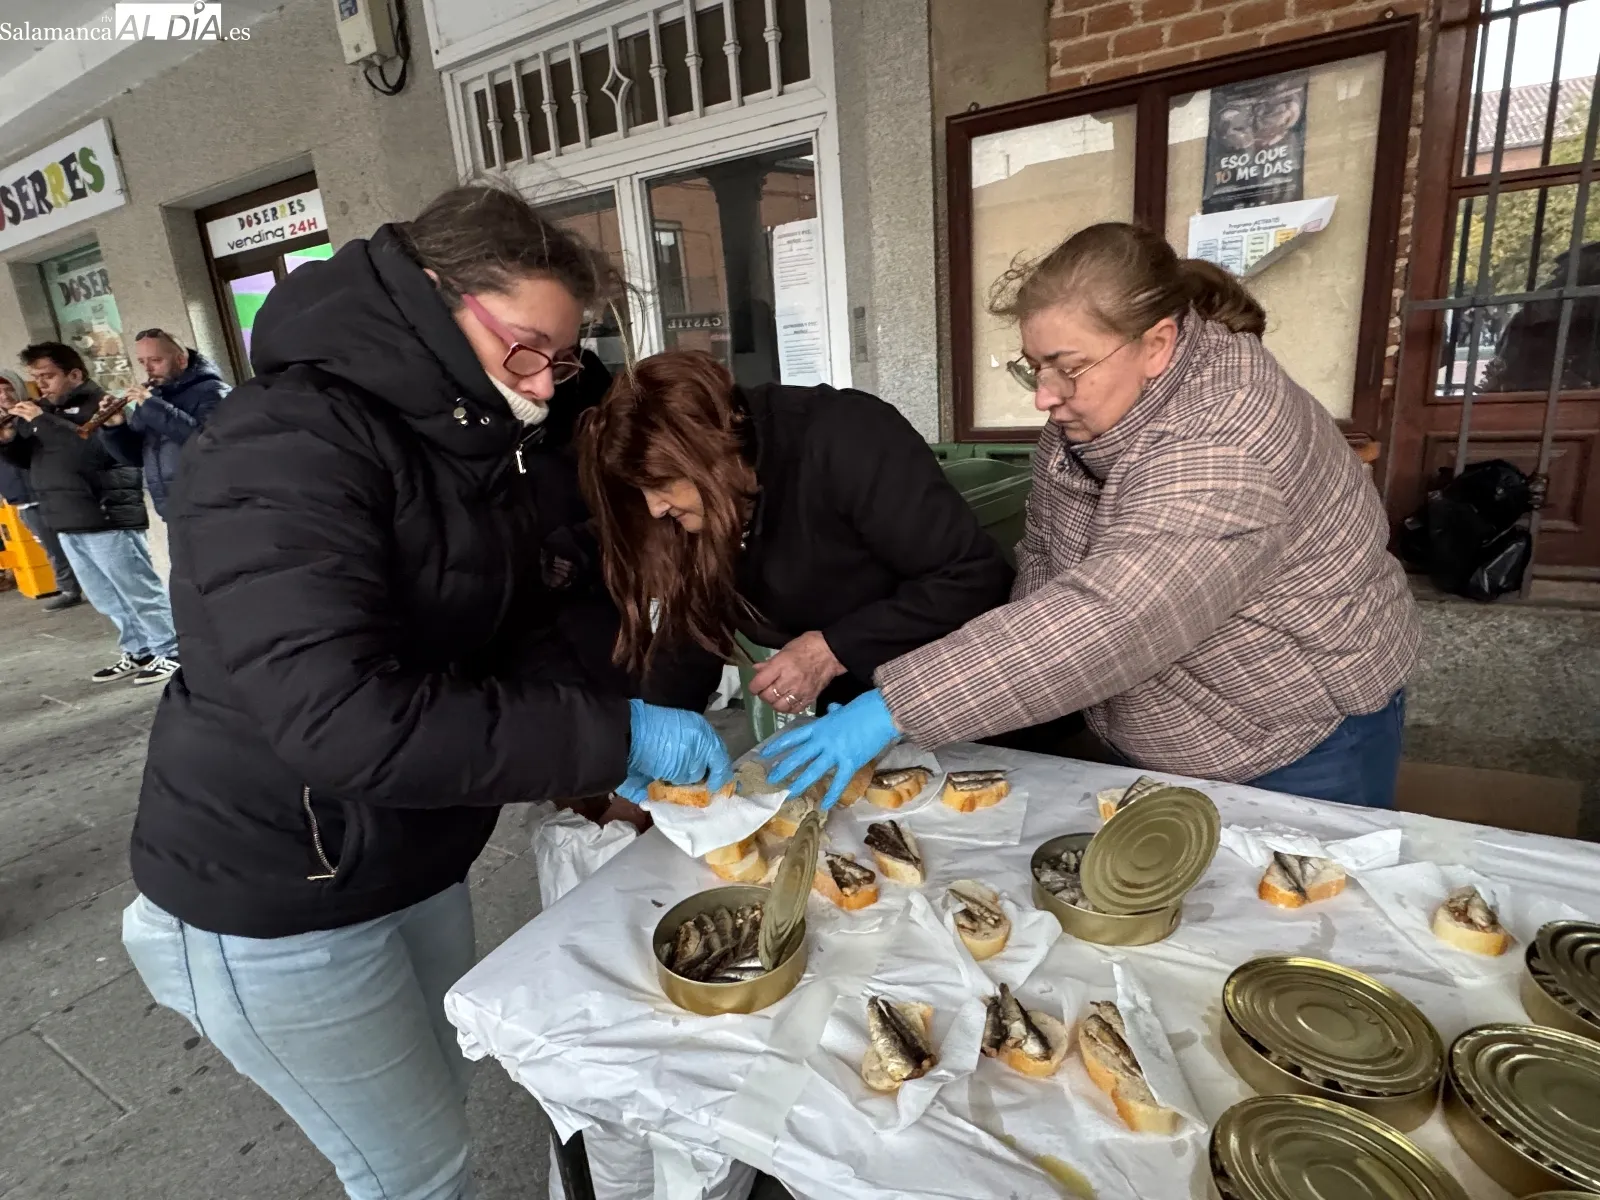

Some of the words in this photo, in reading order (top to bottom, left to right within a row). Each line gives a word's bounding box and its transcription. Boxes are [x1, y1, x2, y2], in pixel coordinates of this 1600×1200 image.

[1220, 153, 1250, 169] ESO
[1255, 145, 1289, 165] QUE
[1235, 165, 1260, 181] ME
[1263, 160, 1293, 178] DAS
[0, 146, 105, 232] SERRES
[237, 198, 306, 230] DOSERRES
[227, 226, 286, 251] vending
[288, 217, 318, 236] 24H
[57, 268, 113, 306] DOSER
